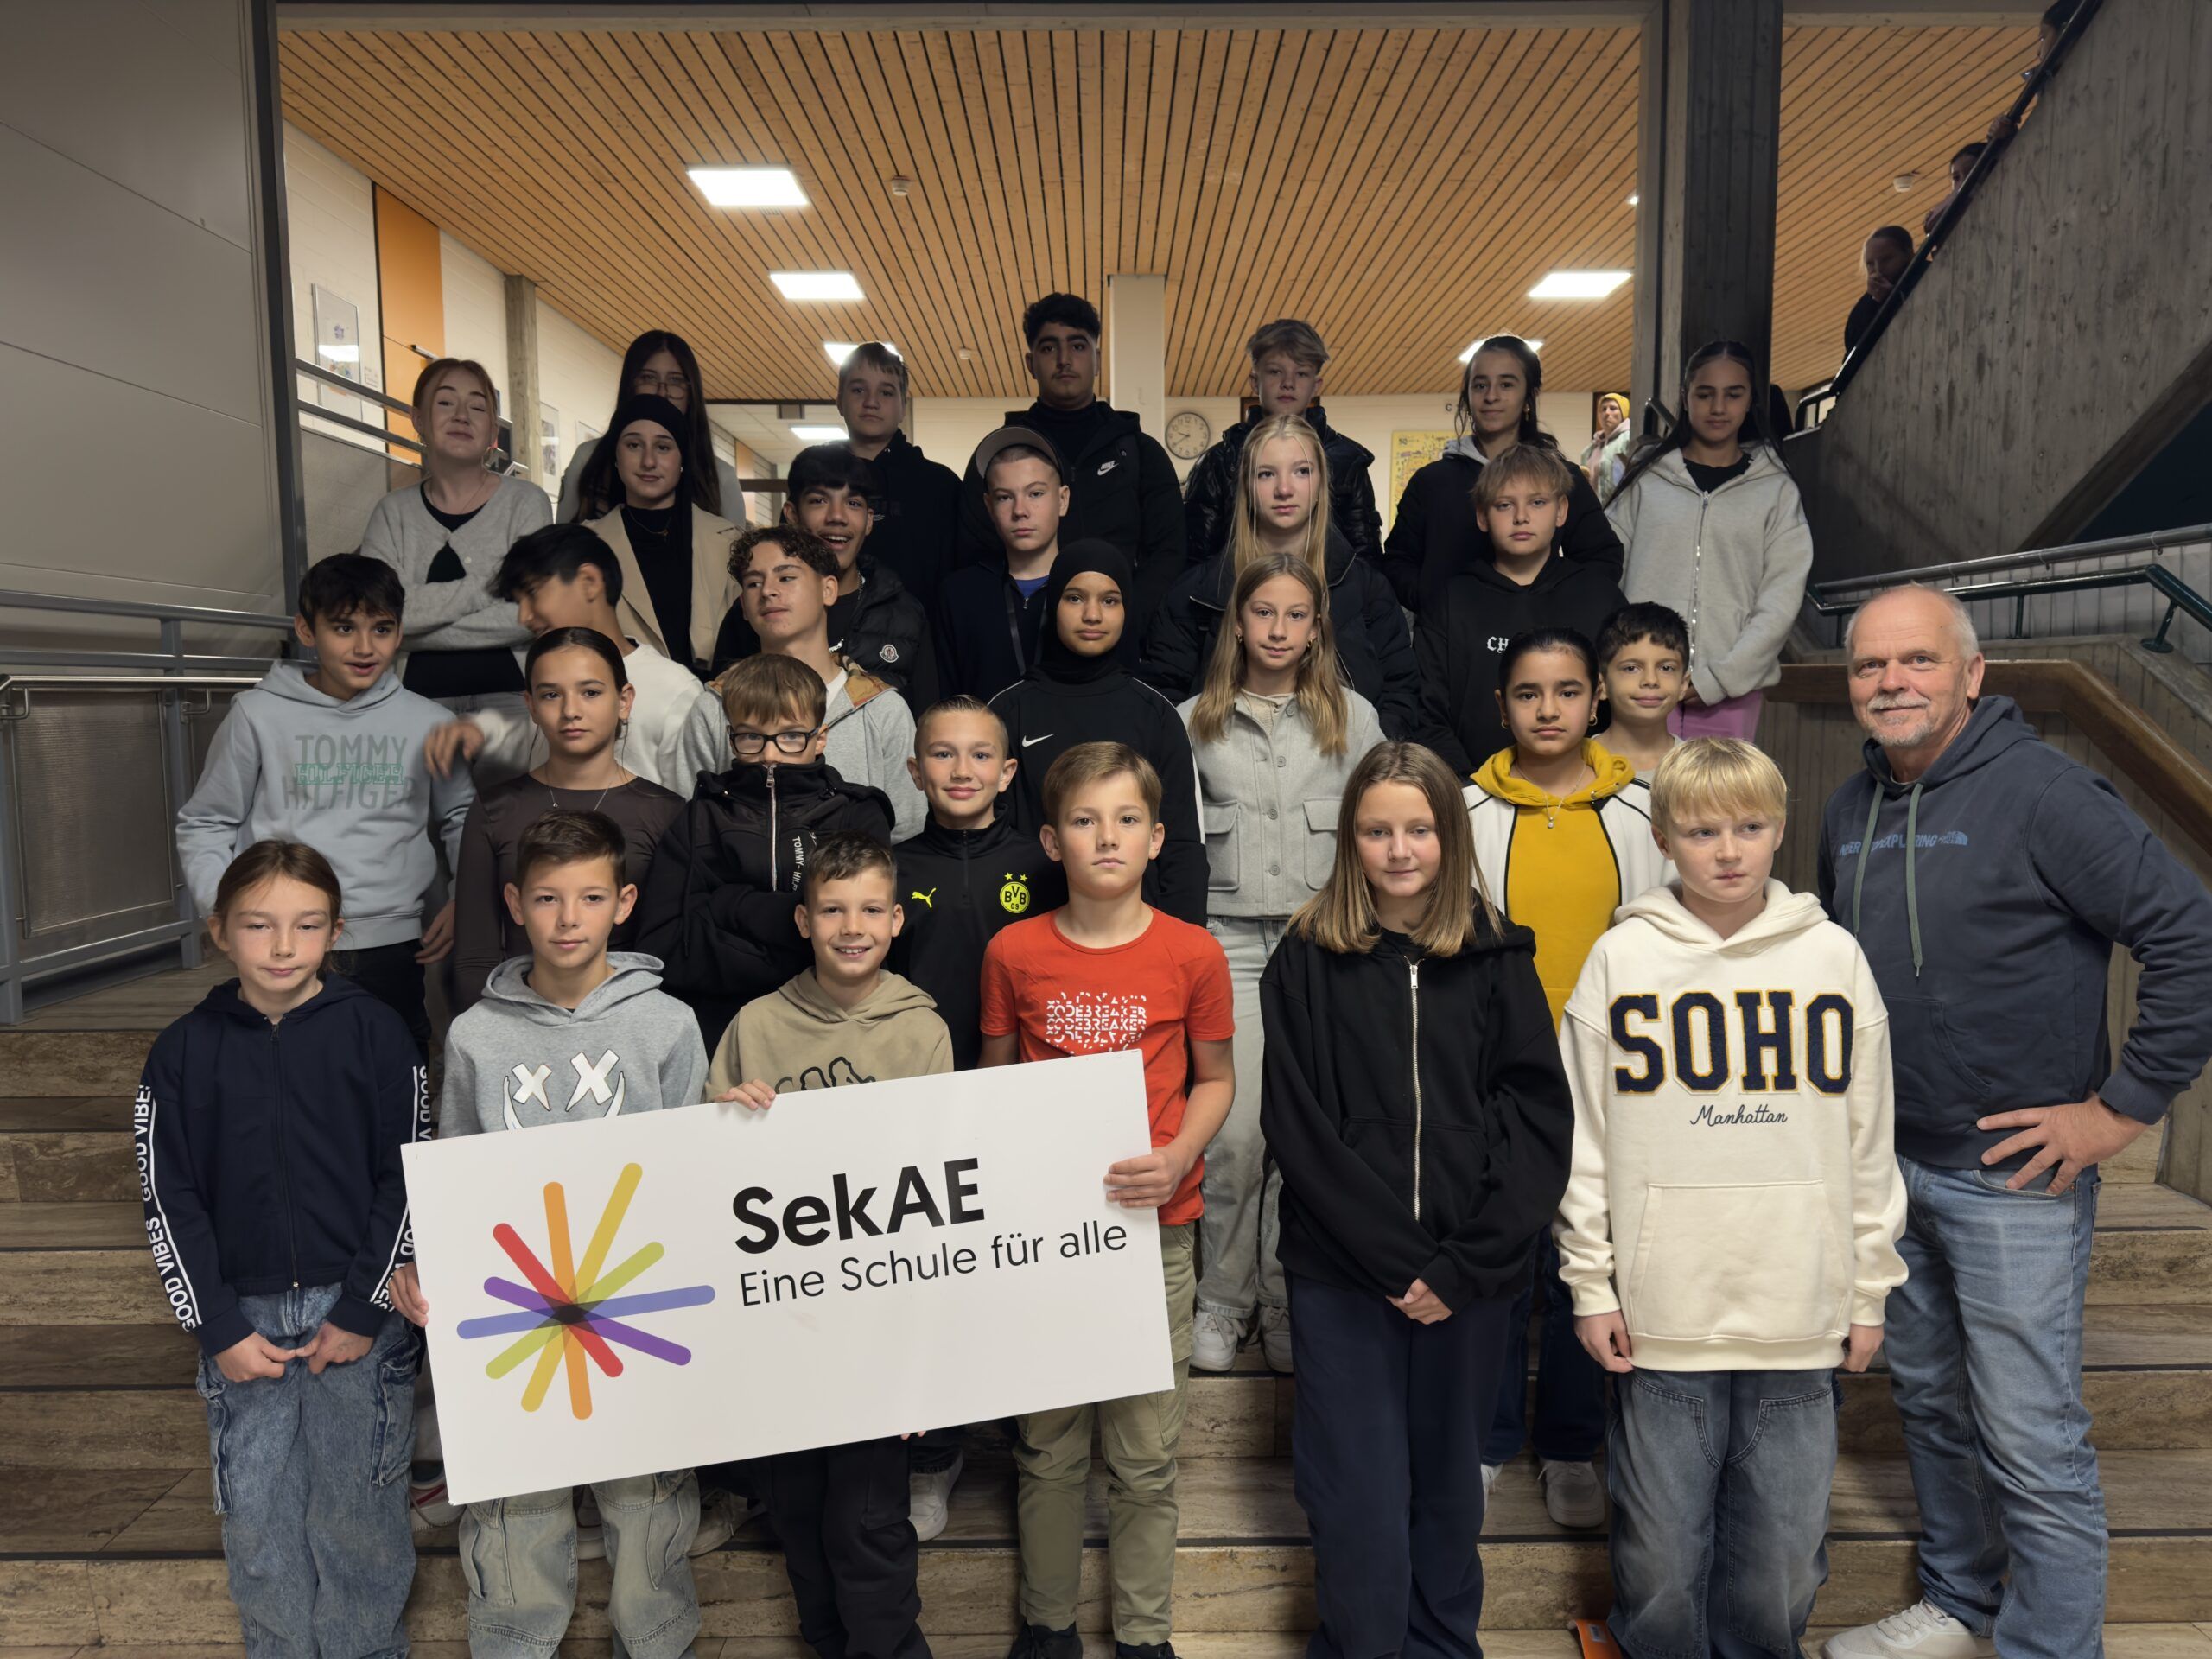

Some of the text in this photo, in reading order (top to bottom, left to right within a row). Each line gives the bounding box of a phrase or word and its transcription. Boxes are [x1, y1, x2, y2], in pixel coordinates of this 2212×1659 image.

[295, 734, 408, 770] TOMMY
[1004, 886, 1027, 905] BVB
[1609, 990, 1854, 1096] SOHO
[1690, 1104, 1788, 1127] Manhattan
[137, 1142, 152, 1202] GOOD
[733, 1157, 985, 1255] SekAE
[145, 1217, 196, 1332] GOOD VIBES
[741, 1219, 1128, 1306] Eine Schule für alle
